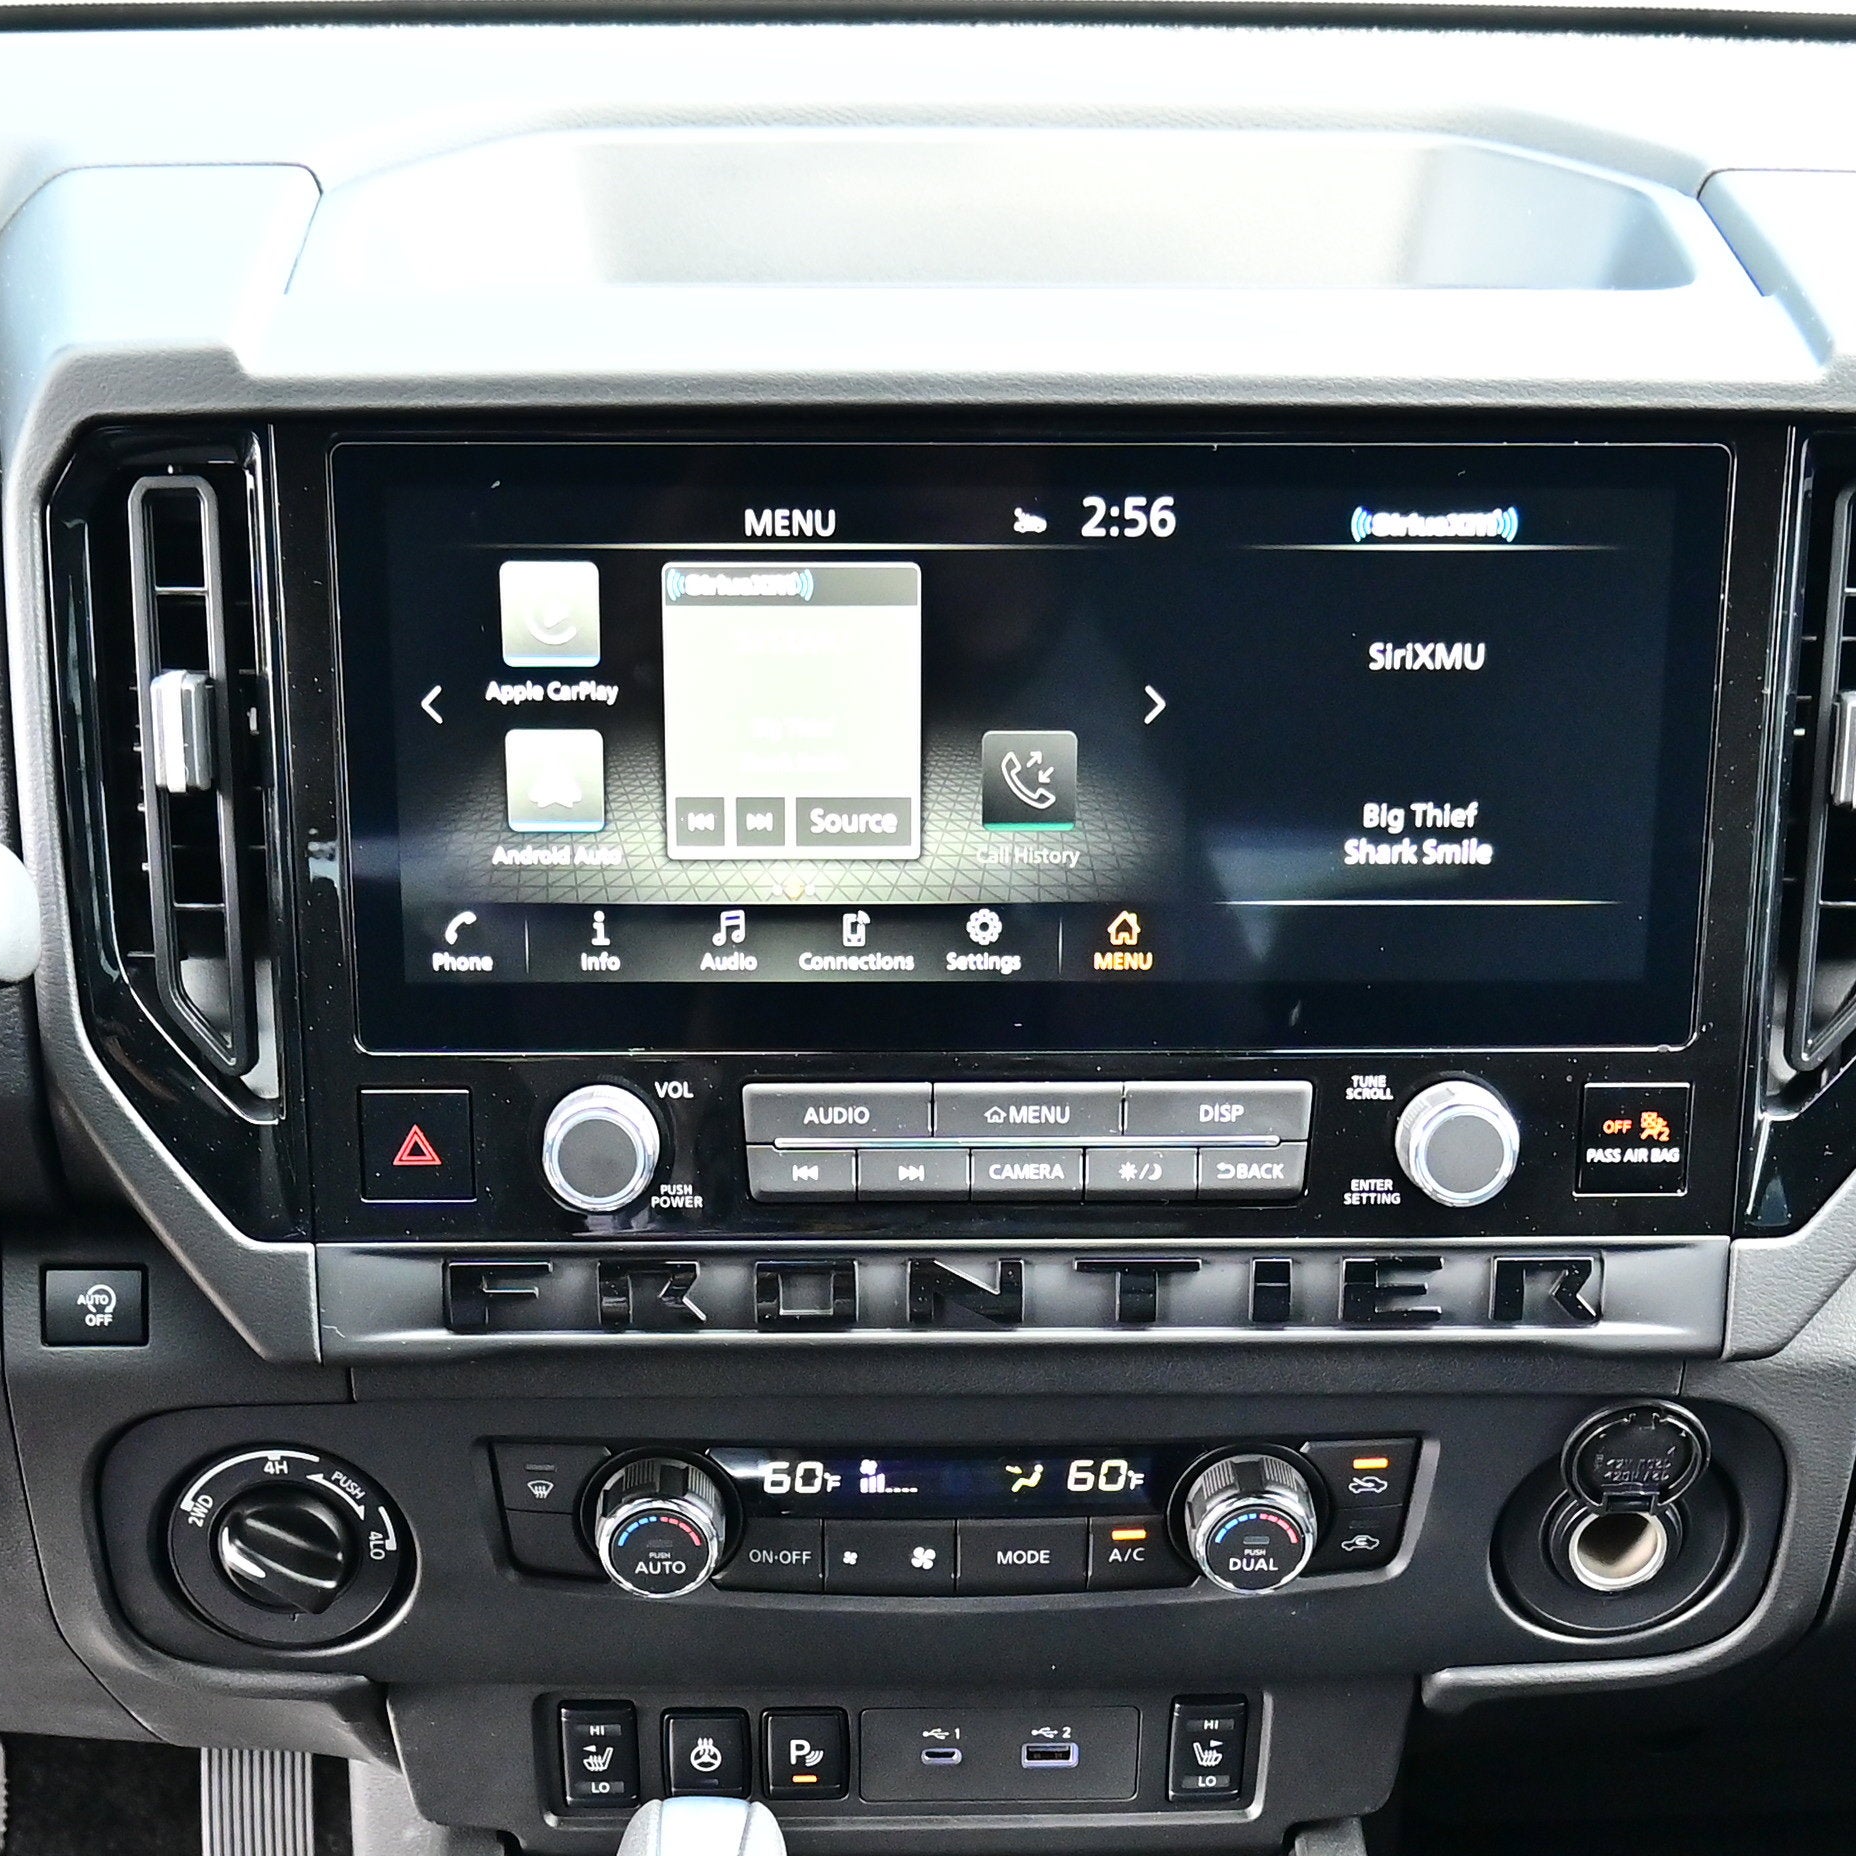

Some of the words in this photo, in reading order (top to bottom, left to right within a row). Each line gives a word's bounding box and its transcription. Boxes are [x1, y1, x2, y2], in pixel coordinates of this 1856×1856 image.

[744, 508, 836, 537] MENU
[1081, 495, 1177, 538] 2:56
[1368, 641, 1486, 671] SiriXMU
[483, 677, 546, 707] Apple
[545, 677, 621, 707] CarPlay
[807, 806, 900, 836] Source
[1359, 800, 1406, 832] Big
[1410, 799, 1481, 832] Thief
[491, 844, 572, 867] Android
[572, 844, 624, 867] Auto
[975, 845, 1011, 866] Call
[1012, 845, 1081, 872] History
[1341, 838, 1419, 867] Shark
[1419, 836, 1495, 867] Smile
[430, 950, 494, 975] Phone
[579, 950, 622, 975] Info
[698, 950, 759, 975] Audio
[796, 950, 916, 975] Connections
[944, 950, 1022, 980] Settings
[1093, 952, 1153, 972] MENU
[654, 1080, 695, 1099] VOL
[1349, 1074, 1390, 1090] TUNE
[1345, 1087, 1396, 1102] SCROLL
[803, 1105, 870, 1125] AUDIO
[1008, 1105, 1071, 1124] MENU
[1199, 1102, 1245, 1123] DISP
[1601, 1118, 1633, 1136] OFF
[1585, 1146, 1622, 1164] PASS
[1622, 1146, 1649, 1164] AIR
[1649, 1146, 1682, 1164] BAG
[988, 1163, 1065, 1180] CAMERA
[1233, 1162, 1285, 1180] BACK
[659, 1183, 693, 1196] PUSH
[1347, 1178, 1396, 1196] ENTER
[651, 1195, 704, 1209] POWER
[1343, 1192, 1401, 1206] SETTING
[76, 1293, 110, 1306] AUTO
[84, 1313, 114, 1327] OFF
[262, 1460, 291, 1476] 4H
[329, 1470, 367, 1501] PUSH
[187, 1494, 214, 1529] 2WD
[368, 1530, 386, 1561] 4LO
[1106, 1544, 1147, 1566] A/C
[994, 1547, 1053, 1567] MODE
[1226, 1554, 1281, 1575] DUAL
[633, 1558, 689, 1577] AUTO
[587, 1723, 607, 1738] HI
[952, 1726, 962, 1741] 1
[1060, 1725, 1074, 1740] 2
[1201, 1717, 1221, 1732] HI
[589, 1779, 611, 1795] LO
[1196, 1773, 1218, 1788] LO
